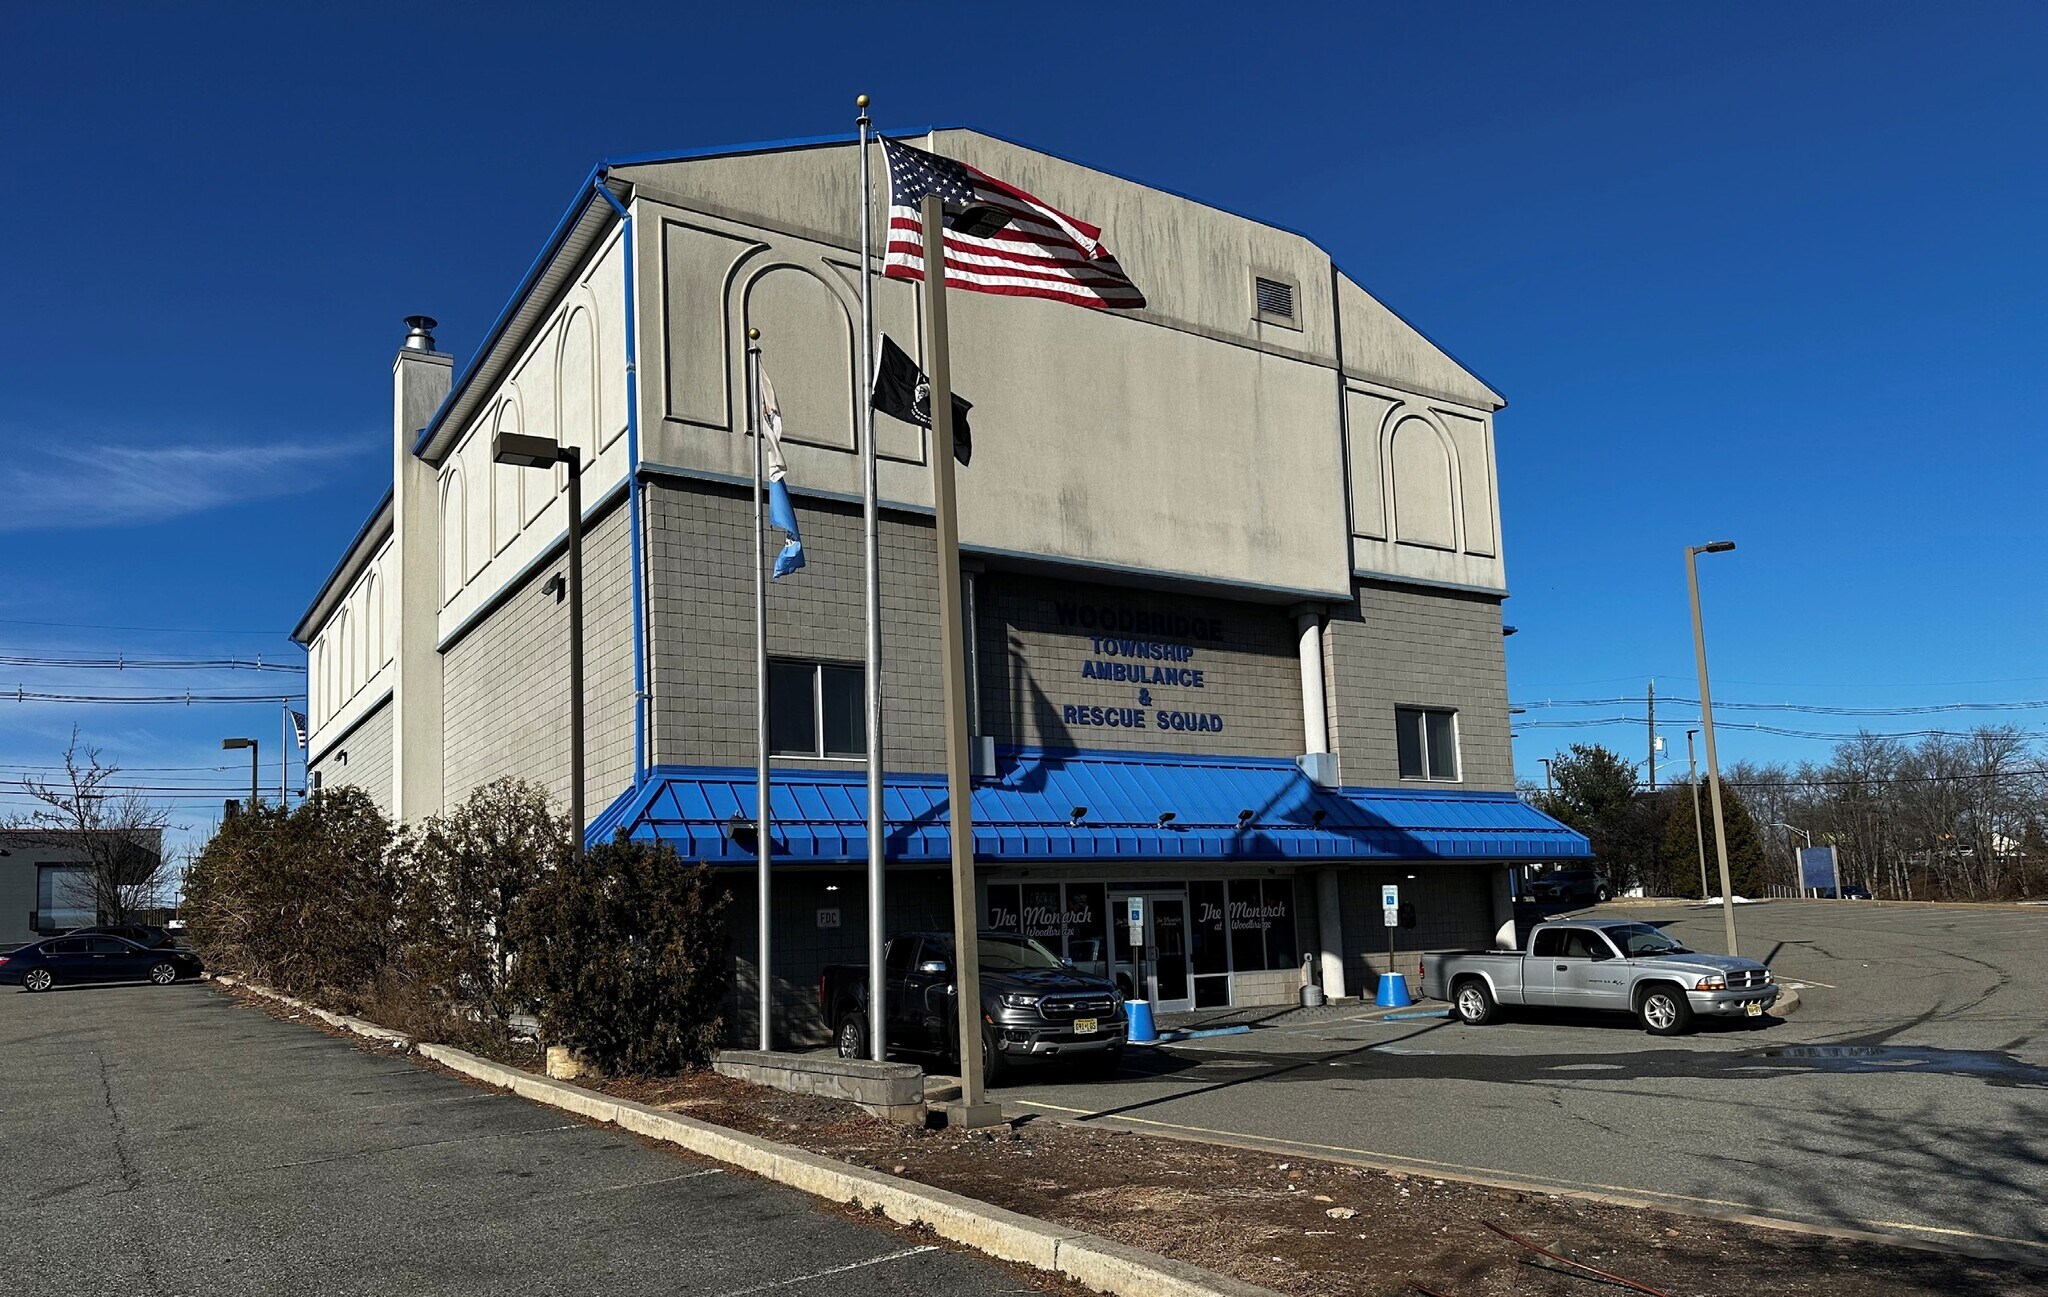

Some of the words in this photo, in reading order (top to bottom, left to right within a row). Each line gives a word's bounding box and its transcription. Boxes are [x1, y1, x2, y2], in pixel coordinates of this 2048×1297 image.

[1055, 602, 1223, 641] WOODBRIDGE
[1090, 636, 1194, 662] TOWNSHIP
[1082, 660, 1204, 687] AMBULANCE
[1138, 687, 1152, 706] &
[1063, 704, 1146, 728] RESCUE
[1156, 710, 1223, 732] SQUAD
[820, 912, 837, 924] FDC
[989, 907, 1017, 930] The
[1024, 906, 1092, 925] Monarch
[1198, 903, 1222, 923] The
[1229, 901, 1286, 919] Monarch
